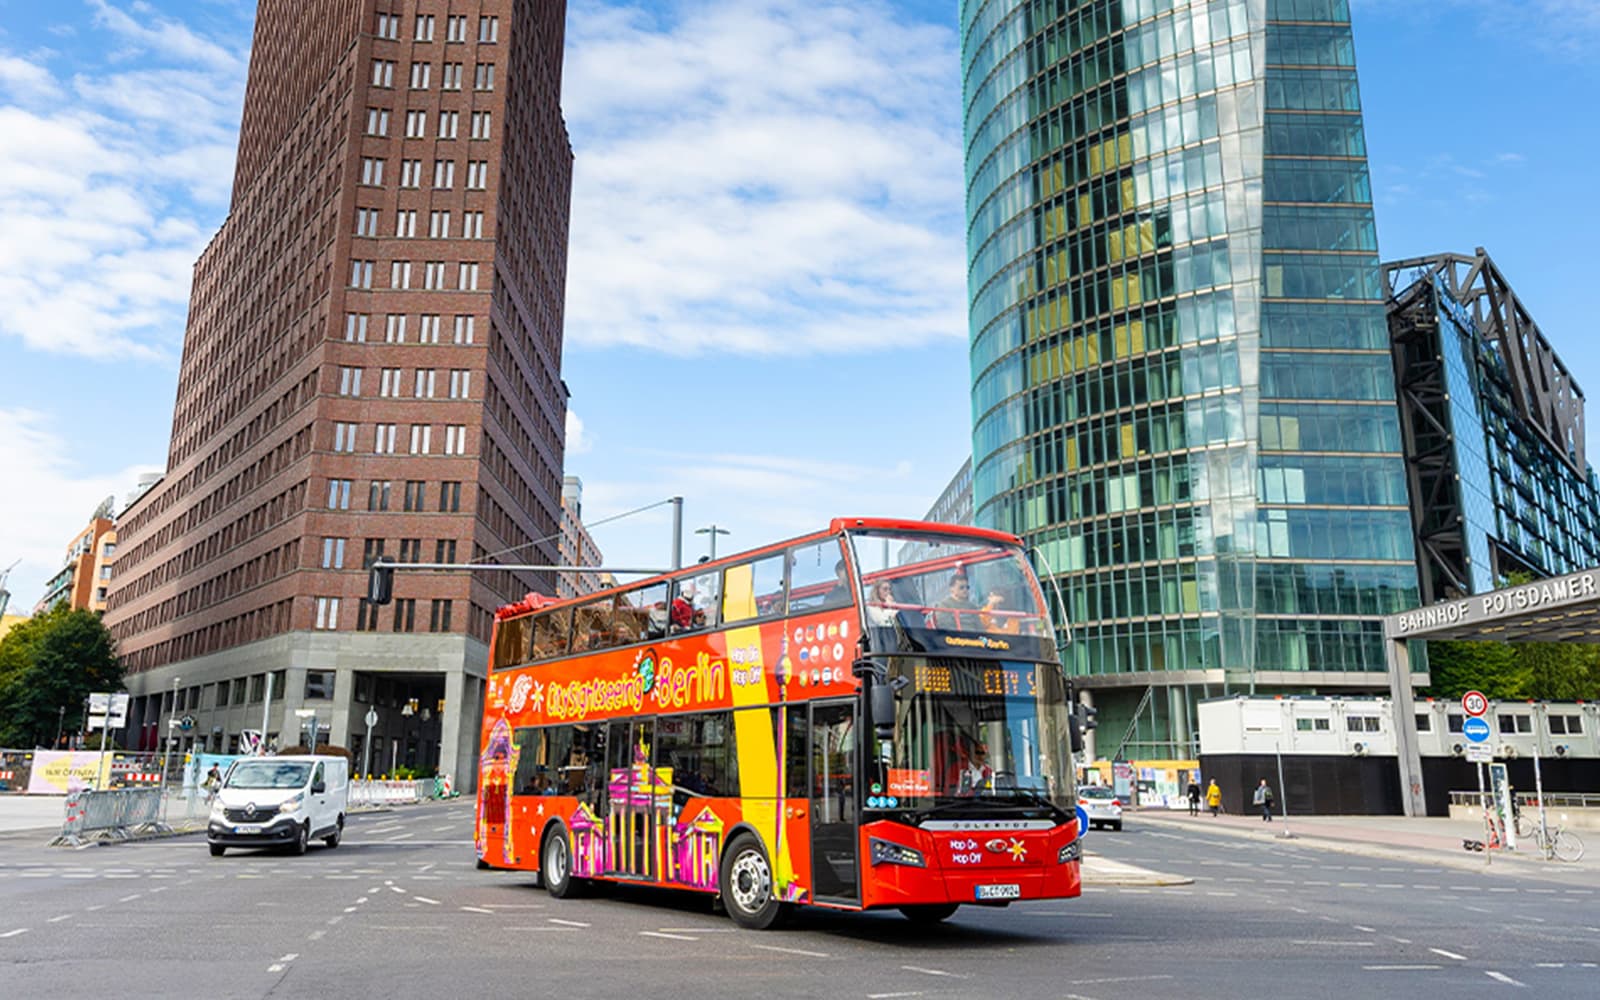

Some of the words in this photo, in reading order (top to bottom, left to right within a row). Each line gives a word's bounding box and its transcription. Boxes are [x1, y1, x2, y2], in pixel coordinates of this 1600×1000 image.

[1399, 602, 1470, 632] BAHNHOF
[1482, 574, 1596, 615] POTSDAMER
[658, 651, 724, 707] Berlin
[733, 668, 748, 687] Hop
[1468, 698, 1483, 710] 30
[950, 840, 966, 850] Hop
[952, 853, 969, 864] Hop
